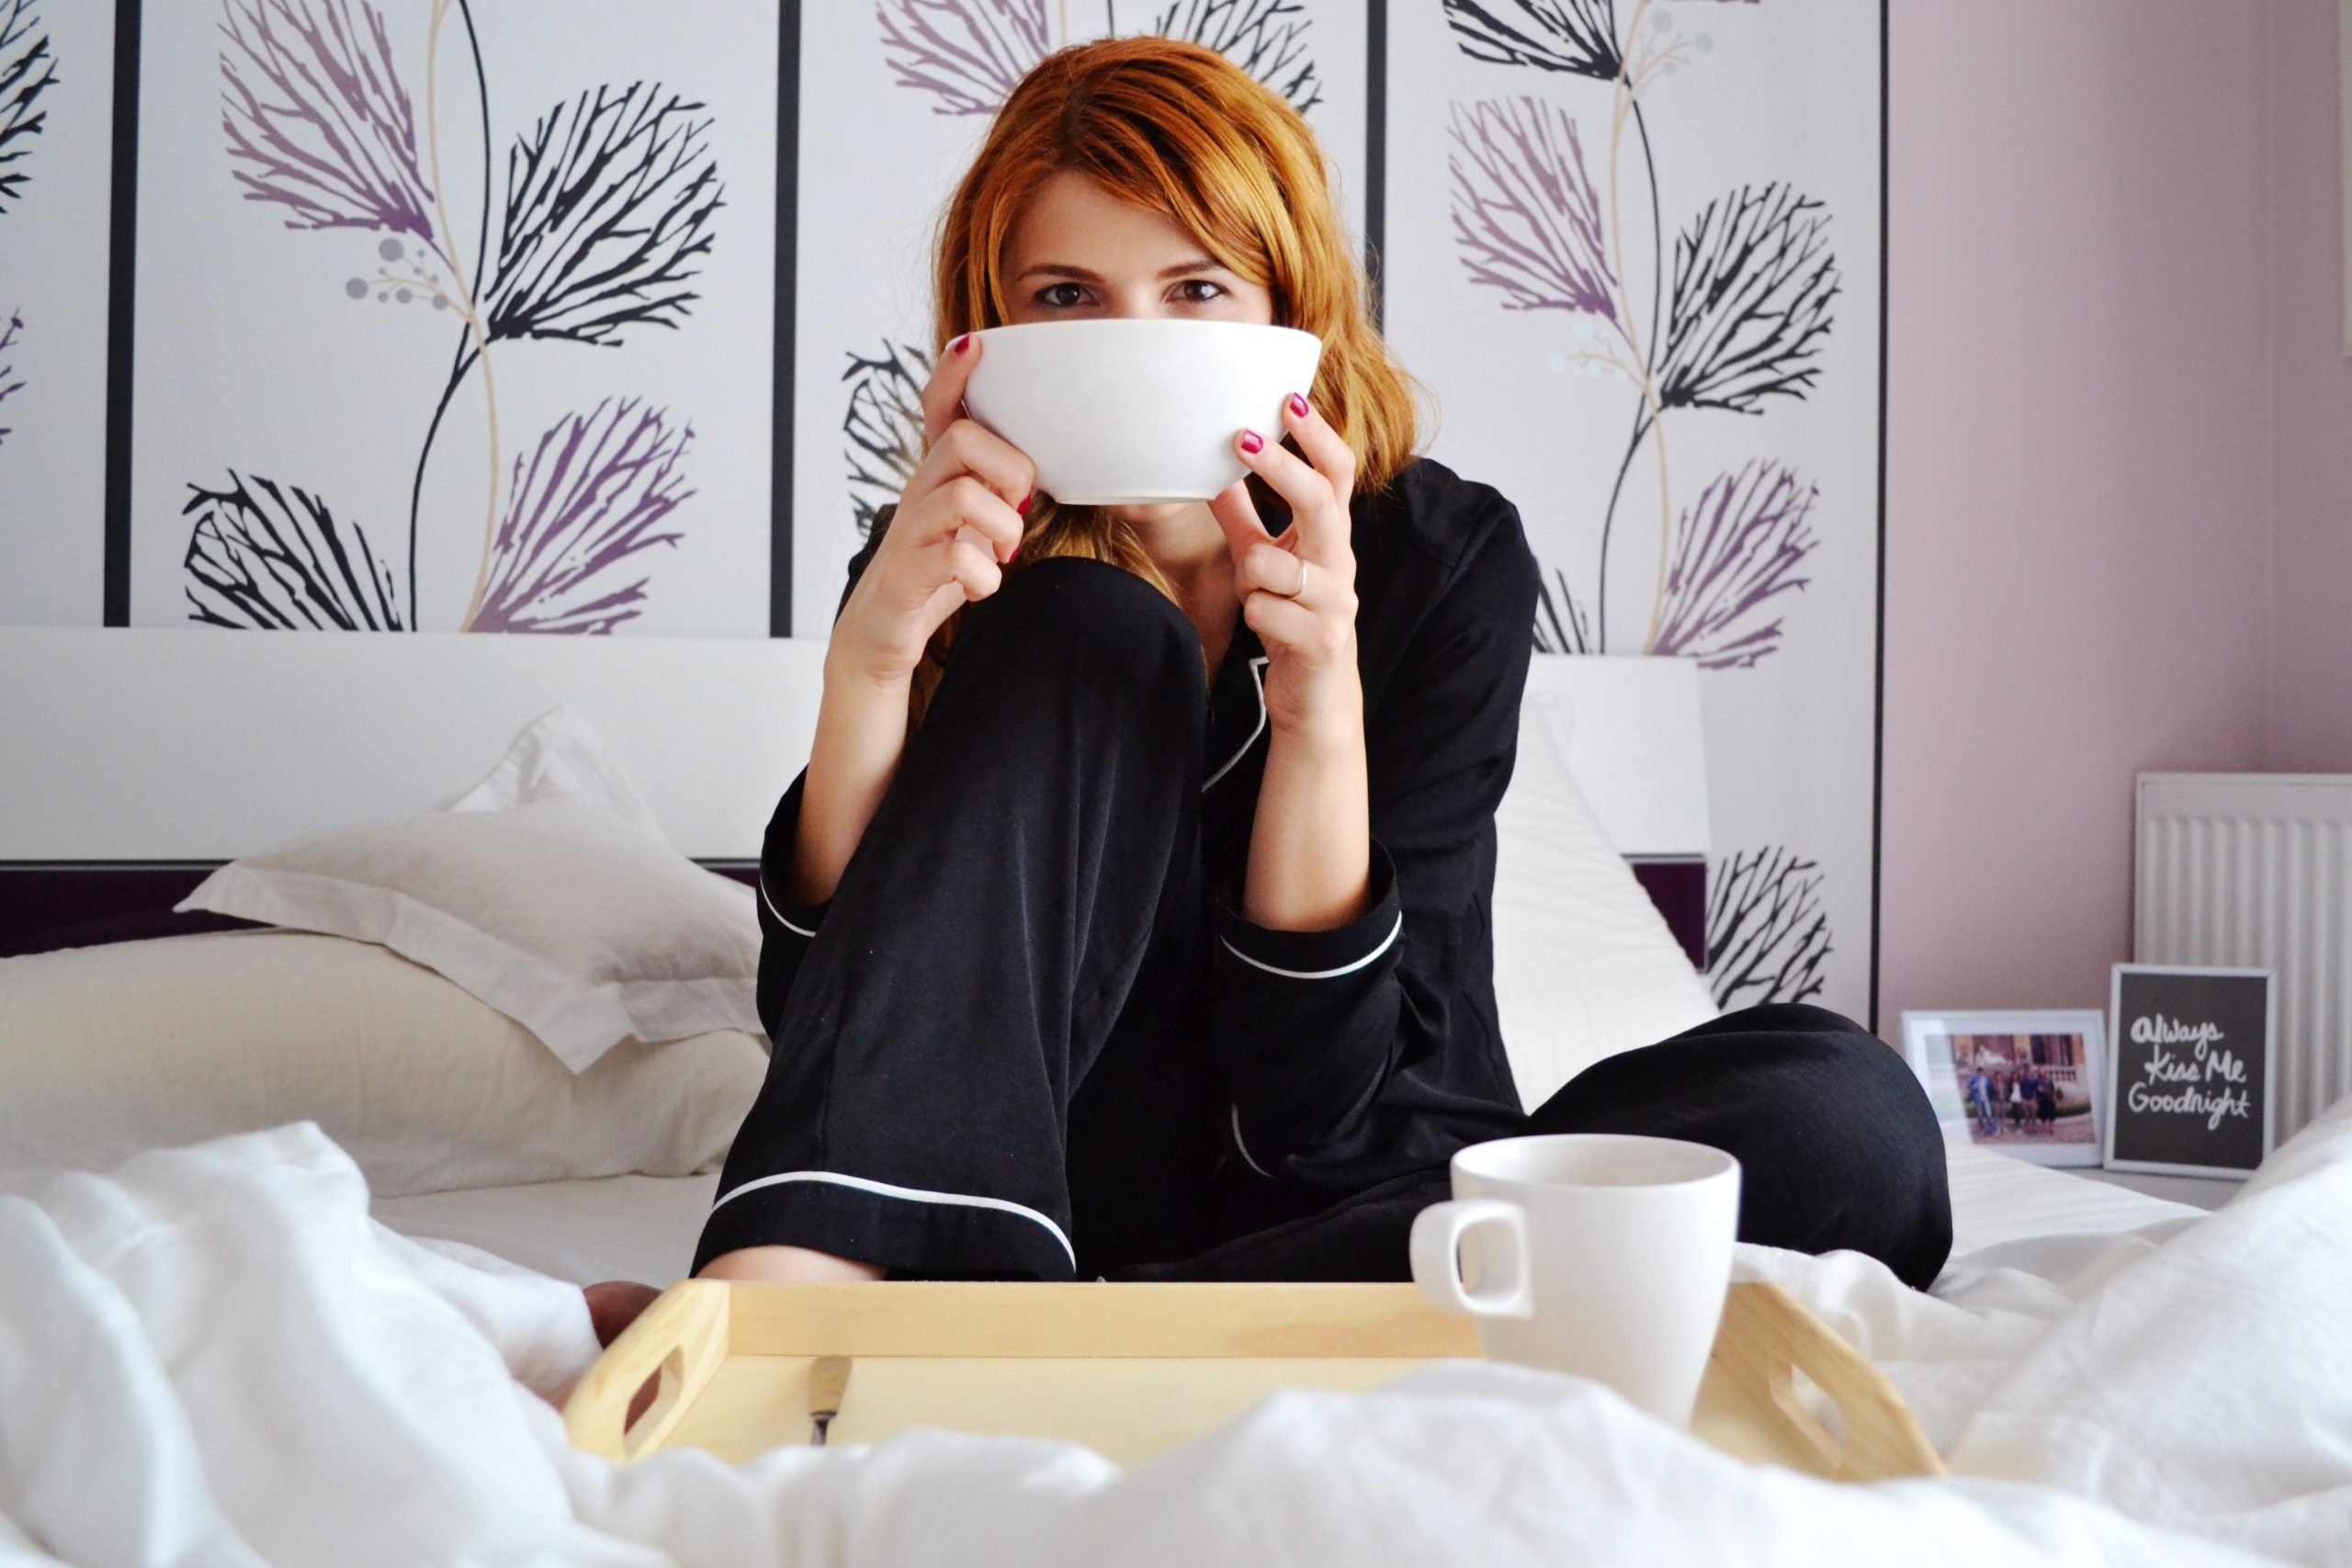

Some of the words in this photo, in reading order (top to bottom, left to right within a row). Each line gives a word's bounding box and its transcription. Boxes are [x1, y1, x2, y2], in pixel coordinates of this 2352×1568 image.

[2143, 1044, 2201, 1085] Kiss
[2205, 1050, 2247, 1083] Me
[2128, 1081, 2251, 1131] Goodnight
